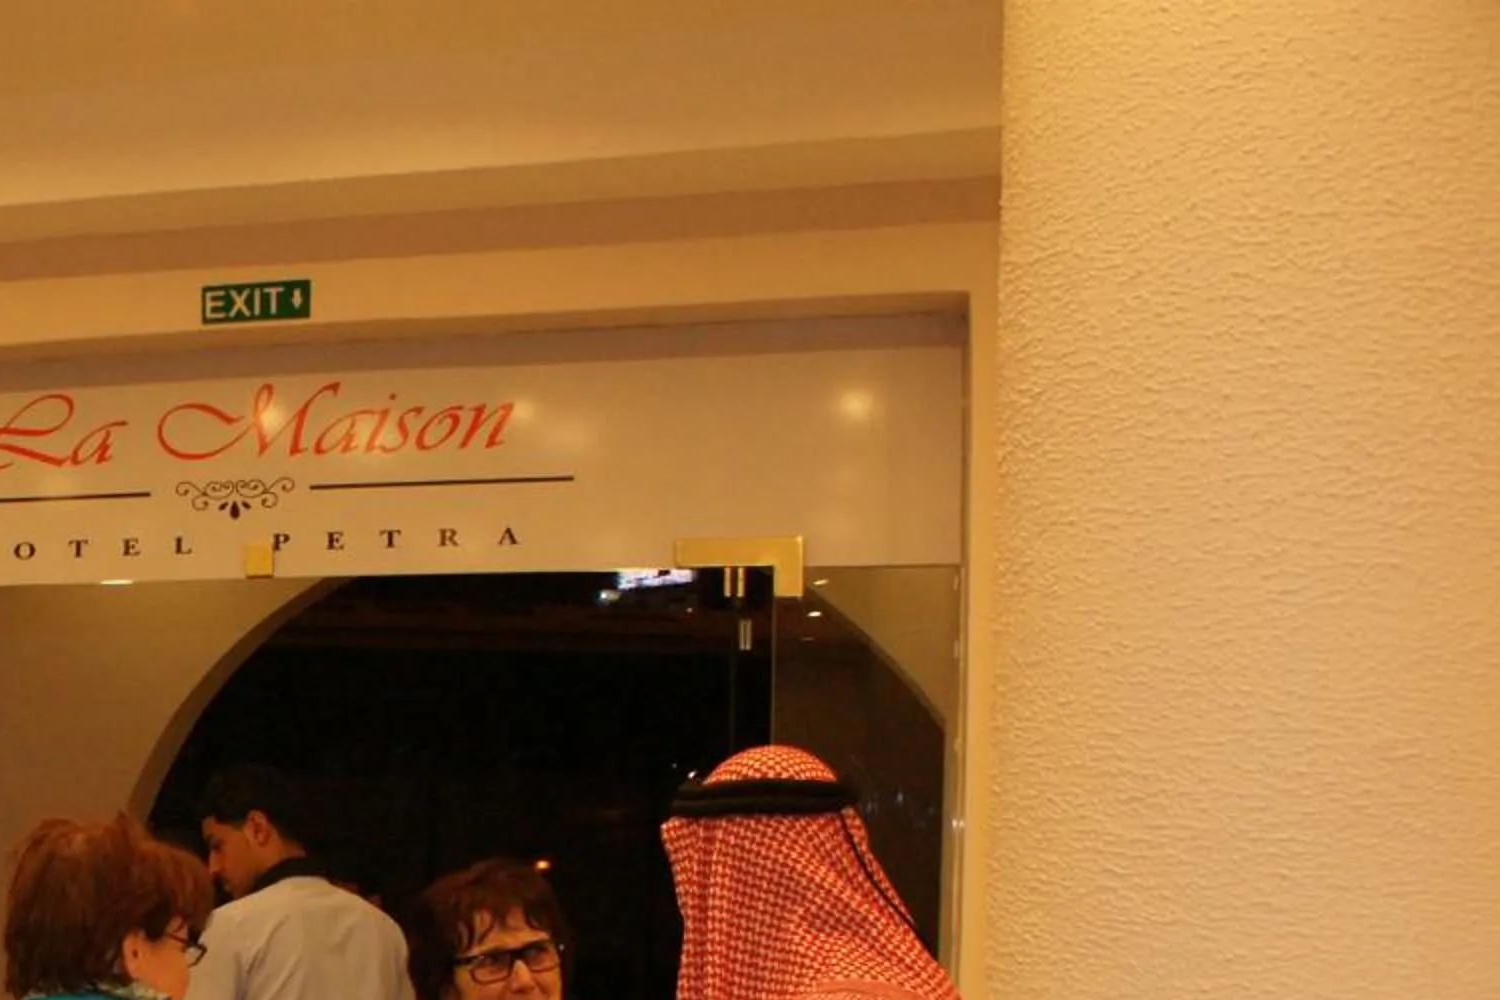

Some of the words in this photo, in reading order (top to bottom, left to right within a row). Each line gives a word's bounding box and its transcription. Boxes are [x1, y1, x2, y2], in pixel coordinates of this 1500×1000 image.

[204, 287, 286, 319] EXIT
[158, 381, 516, 462] Maison
[273, 527, 519, 552] PETRA
